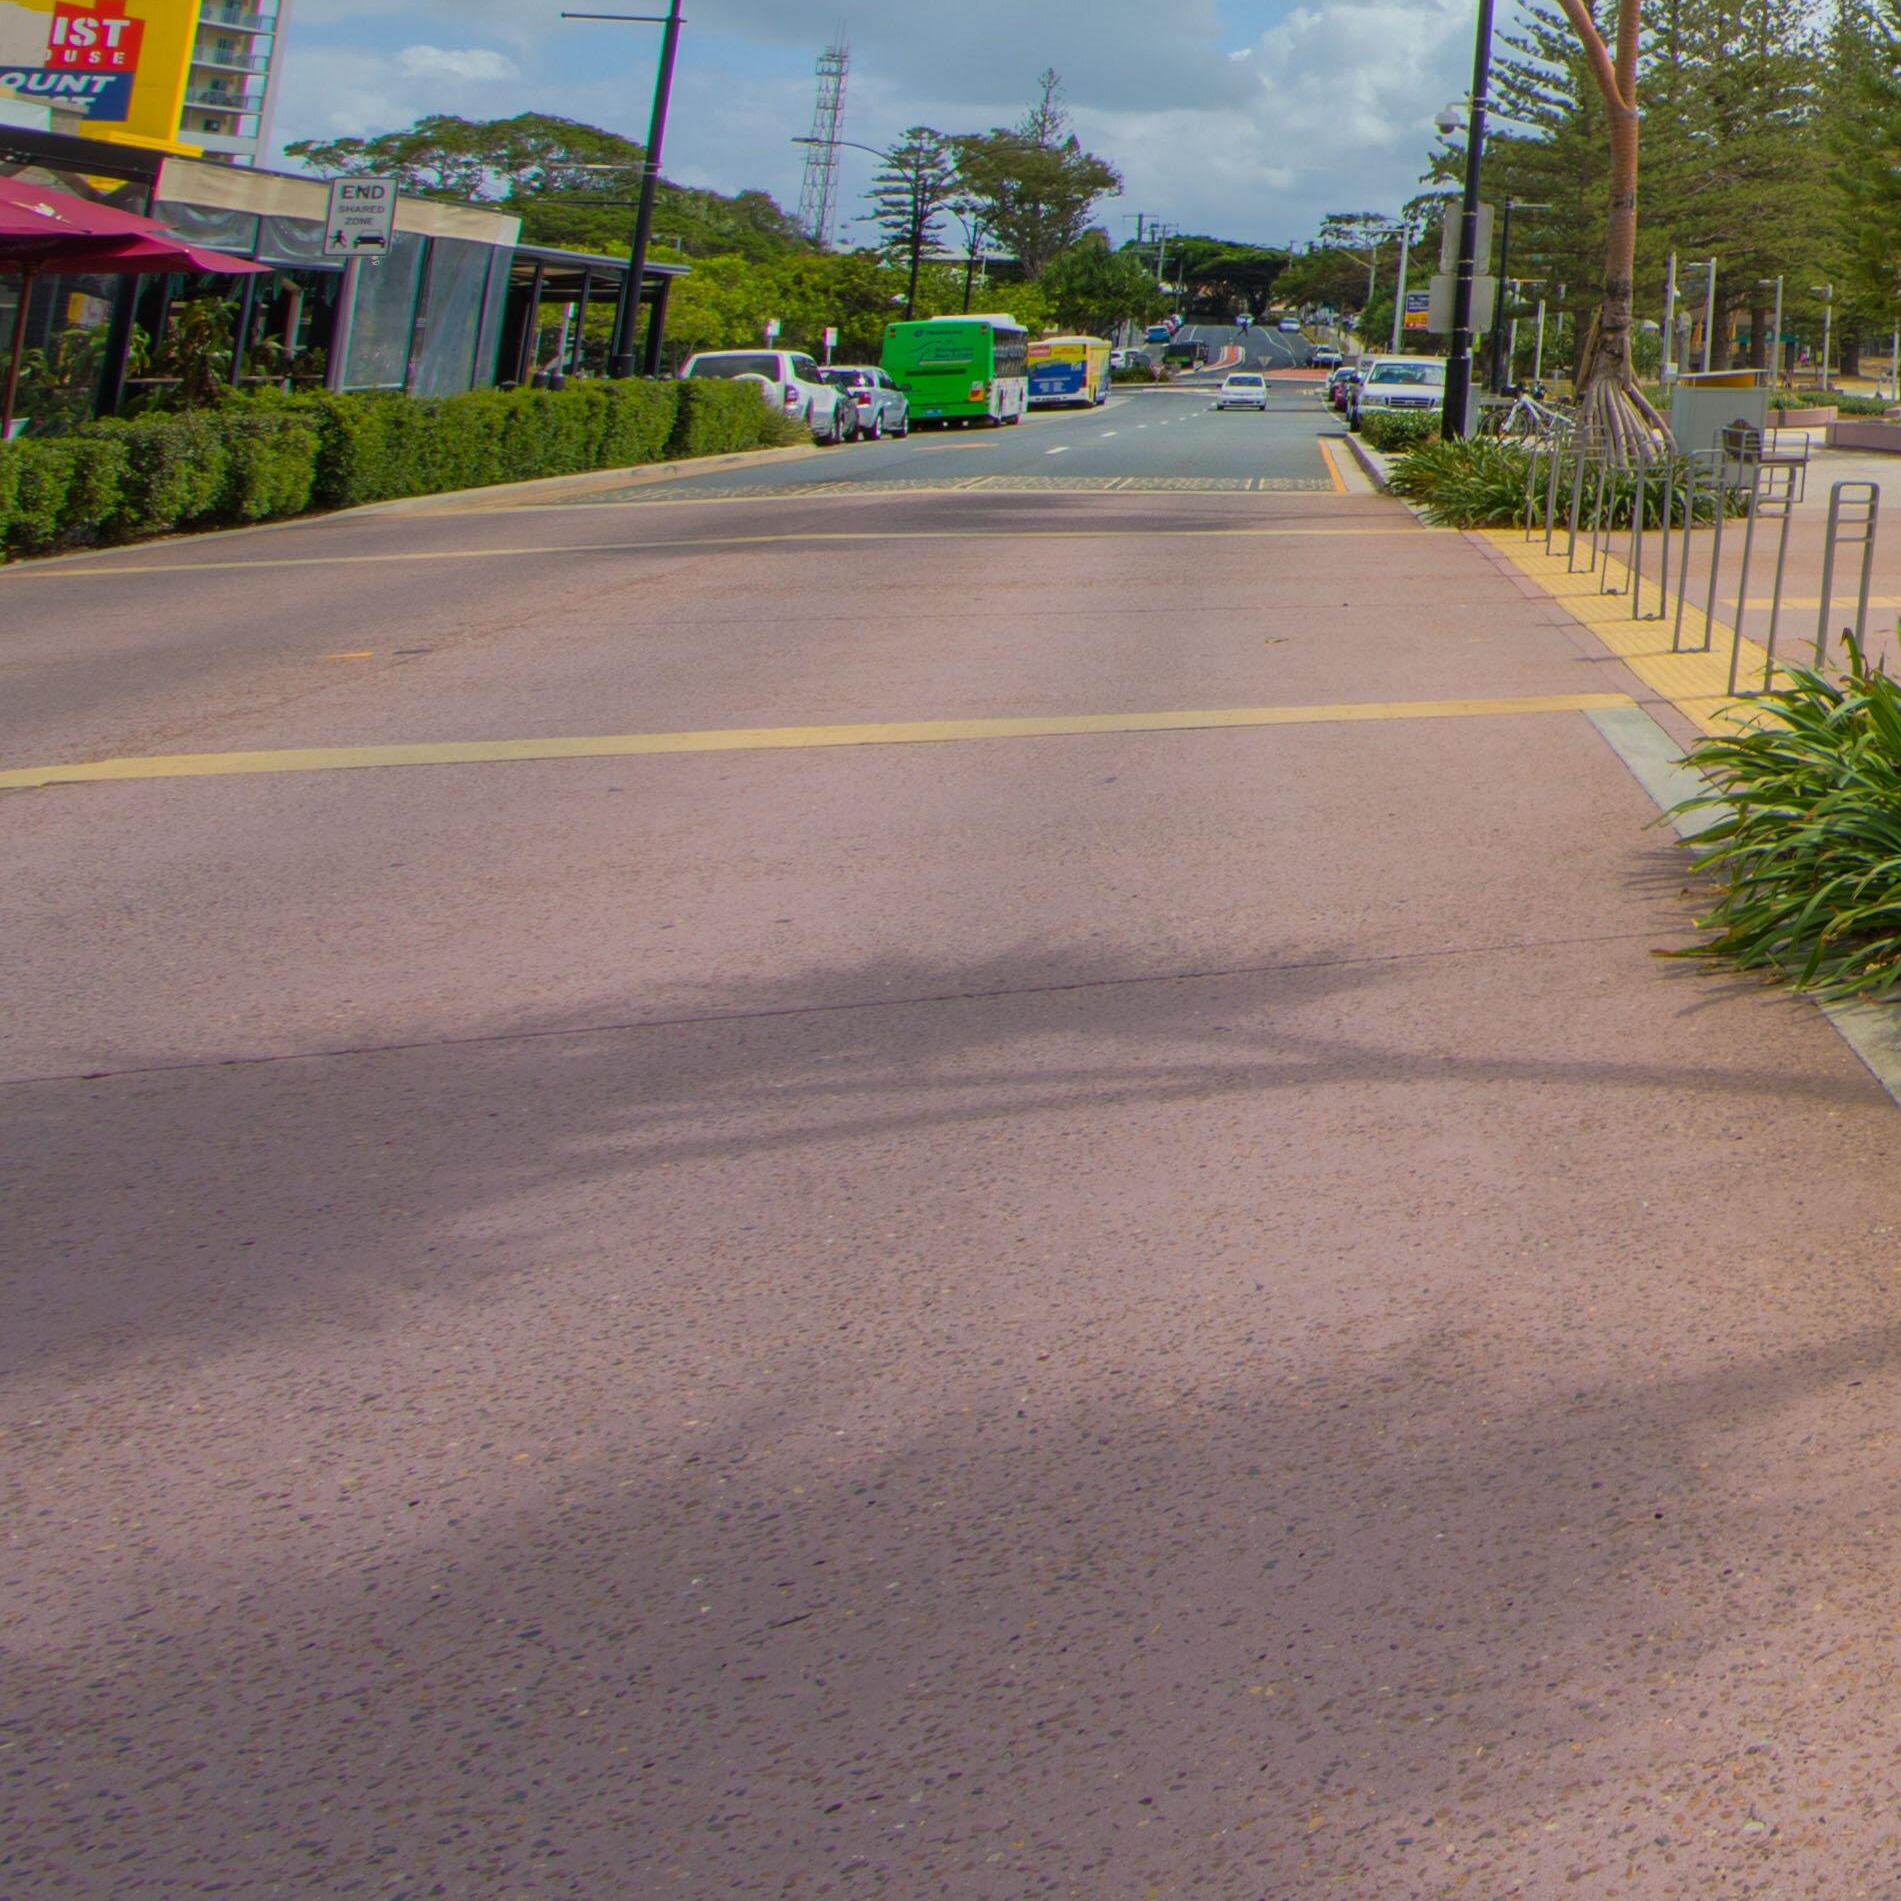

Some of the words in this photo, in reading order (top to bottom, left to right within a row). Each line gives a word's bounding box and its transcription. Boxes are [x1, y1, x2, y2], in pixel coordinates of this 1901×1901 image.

[342, 185, 385, 199] END
[338, 205, 385, 214] SHARED
[344, 217, 375, 226] ZONE
